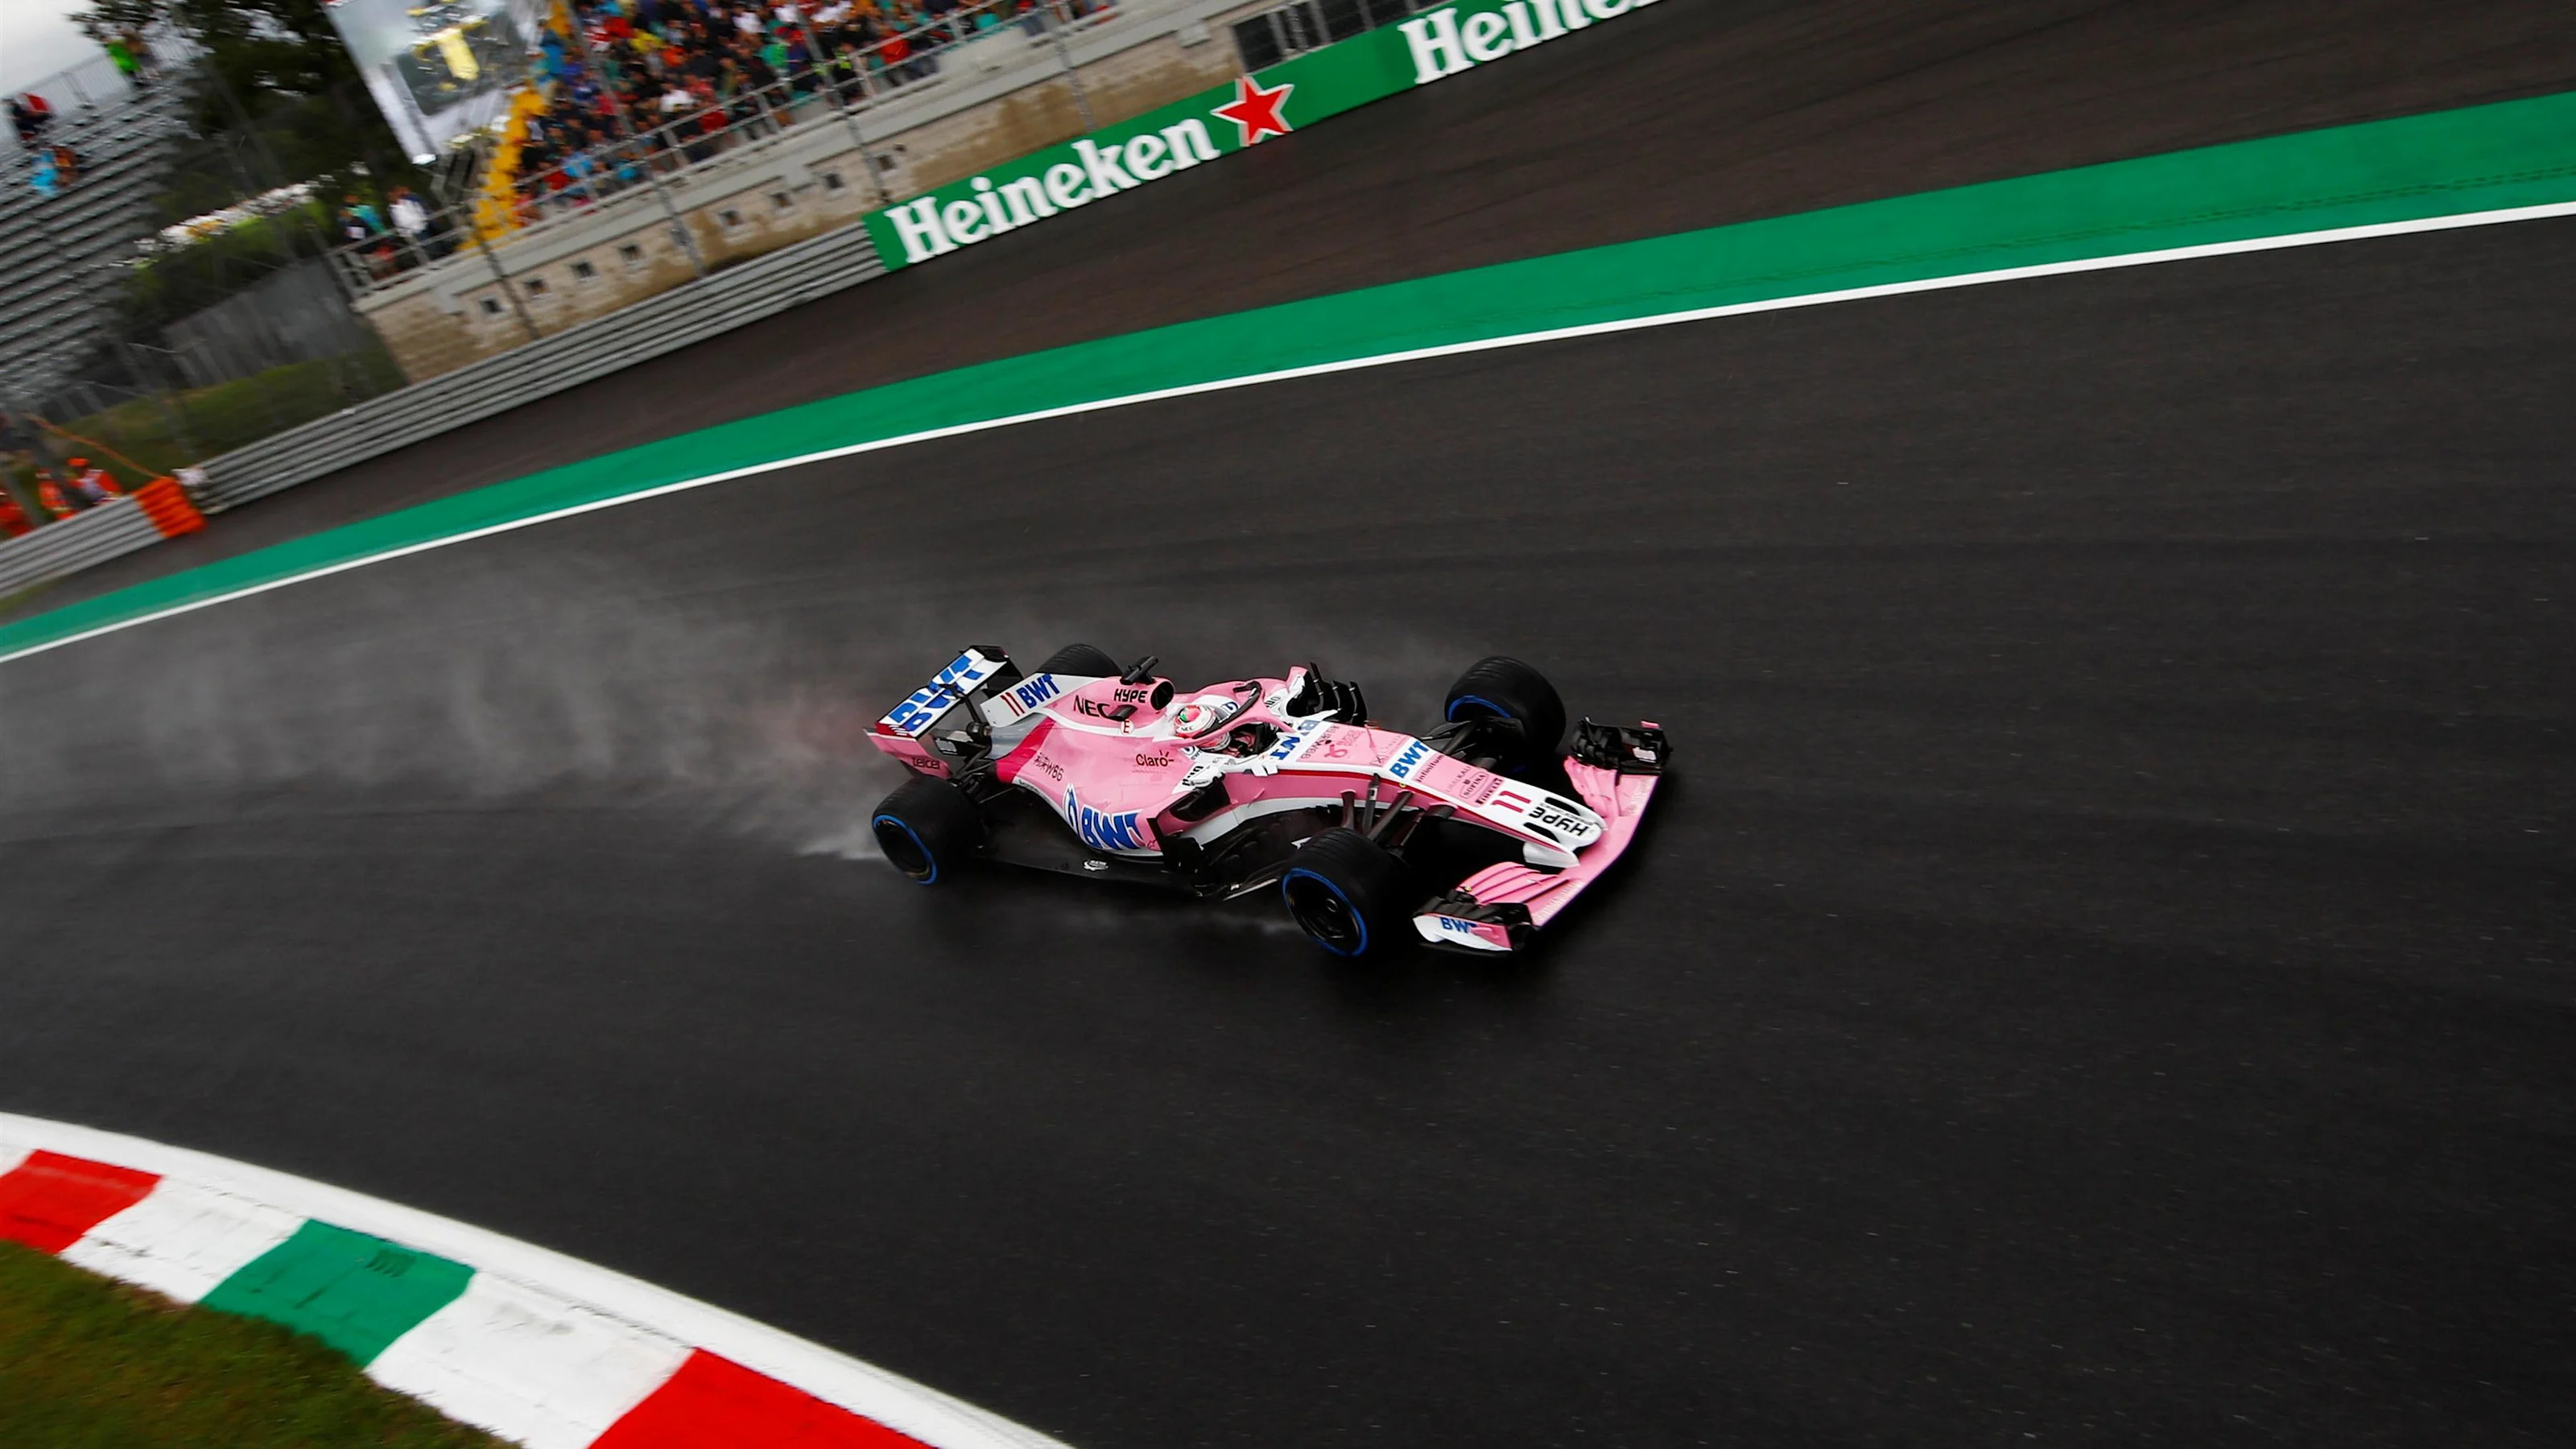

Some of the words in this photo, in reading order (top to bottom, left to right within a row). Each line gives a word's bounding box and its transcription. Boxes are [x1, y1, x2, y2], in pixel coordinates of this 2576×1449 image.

[1397, 0, 1666, 84] Hein
[884, 118, 1221, 264] Heineken
[1016, 673, 1060, 709] BWT
[1073, 695, 1122, 721] NEC
[1114, 688, 1148, 704] HYPE
[1136, 750, 1174, 767] Claro
[1389, 741, 1429, 778] BWT
[1081, 806, 1144, 851] BWT
[1529, 807, 1589, 836] HYPE
